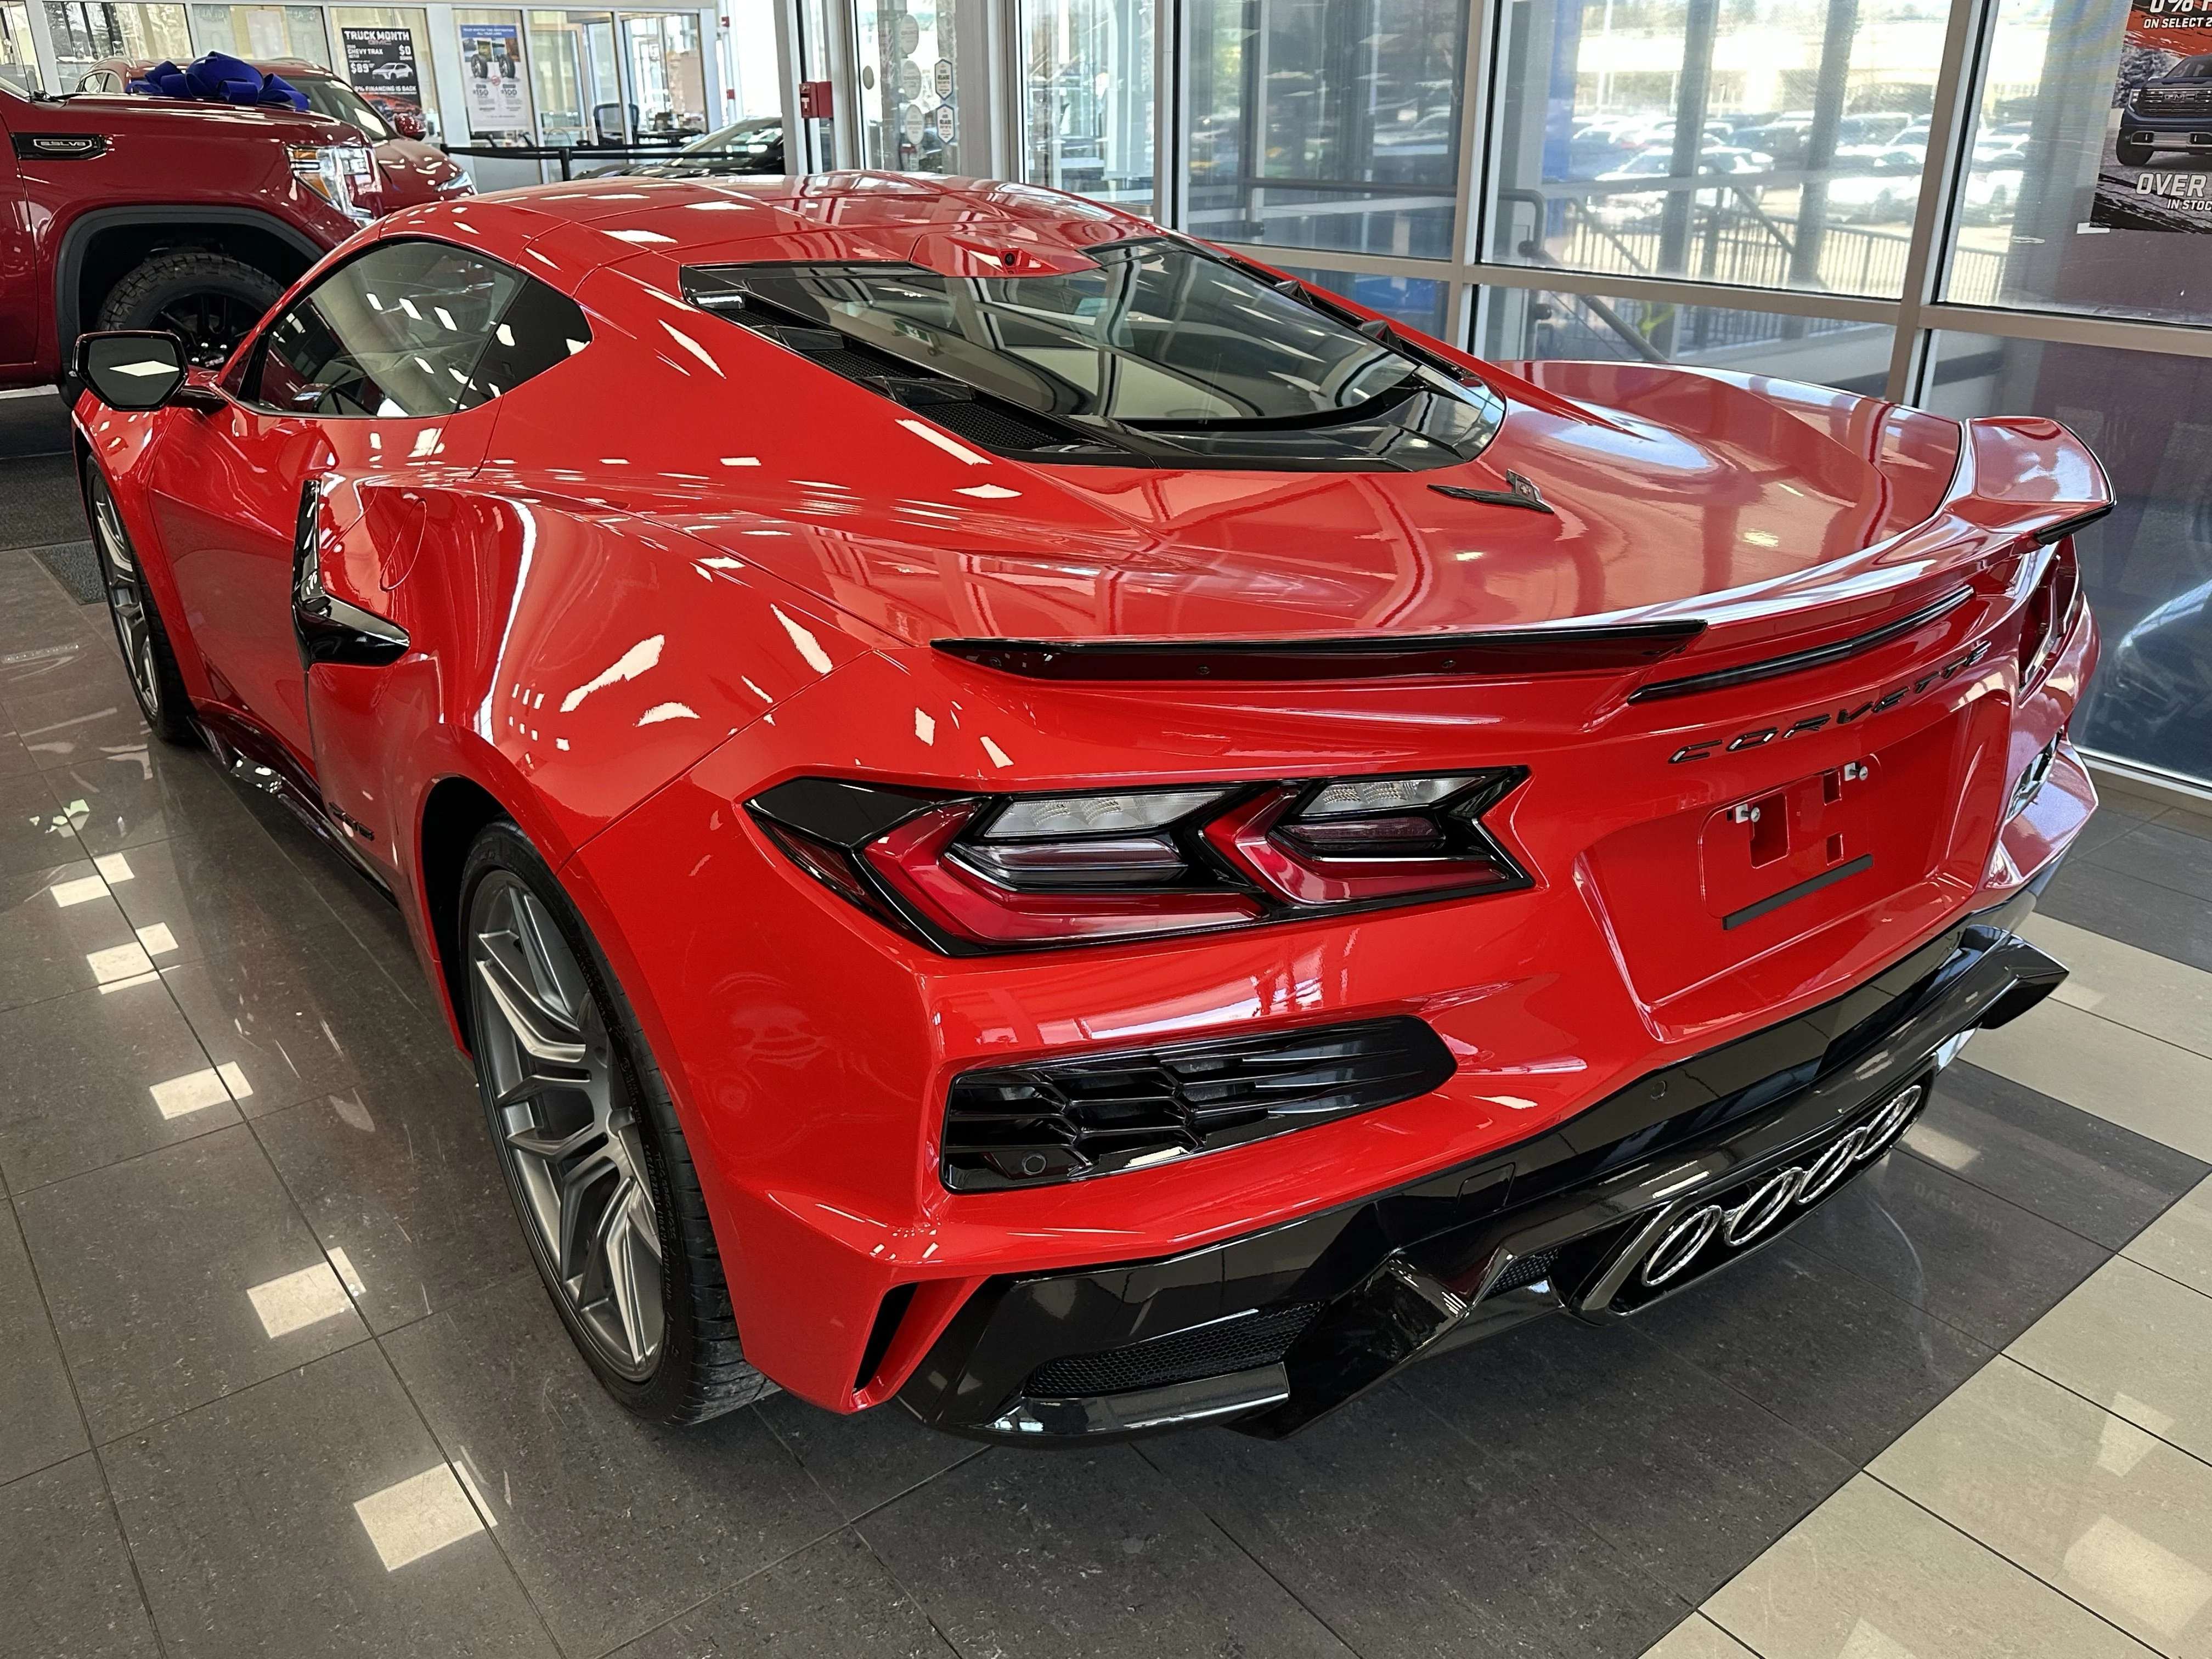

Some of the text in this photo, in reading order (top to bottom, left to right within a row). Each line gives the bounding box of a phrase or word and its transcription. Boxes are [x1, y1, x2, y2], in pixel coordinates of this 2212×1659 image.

[2143, 18, 2160, 29] ON
[2162, 17, 2204, 28] SELECT
[344, 31, 410, 41] TRUCK MONTH
[399, 44, 411, 56] $0
[2136, 173, 2207, 197] OVER
[2167, 199, 2181, 209] IN
[1667, 640, 1991, 763] CORVETTE
